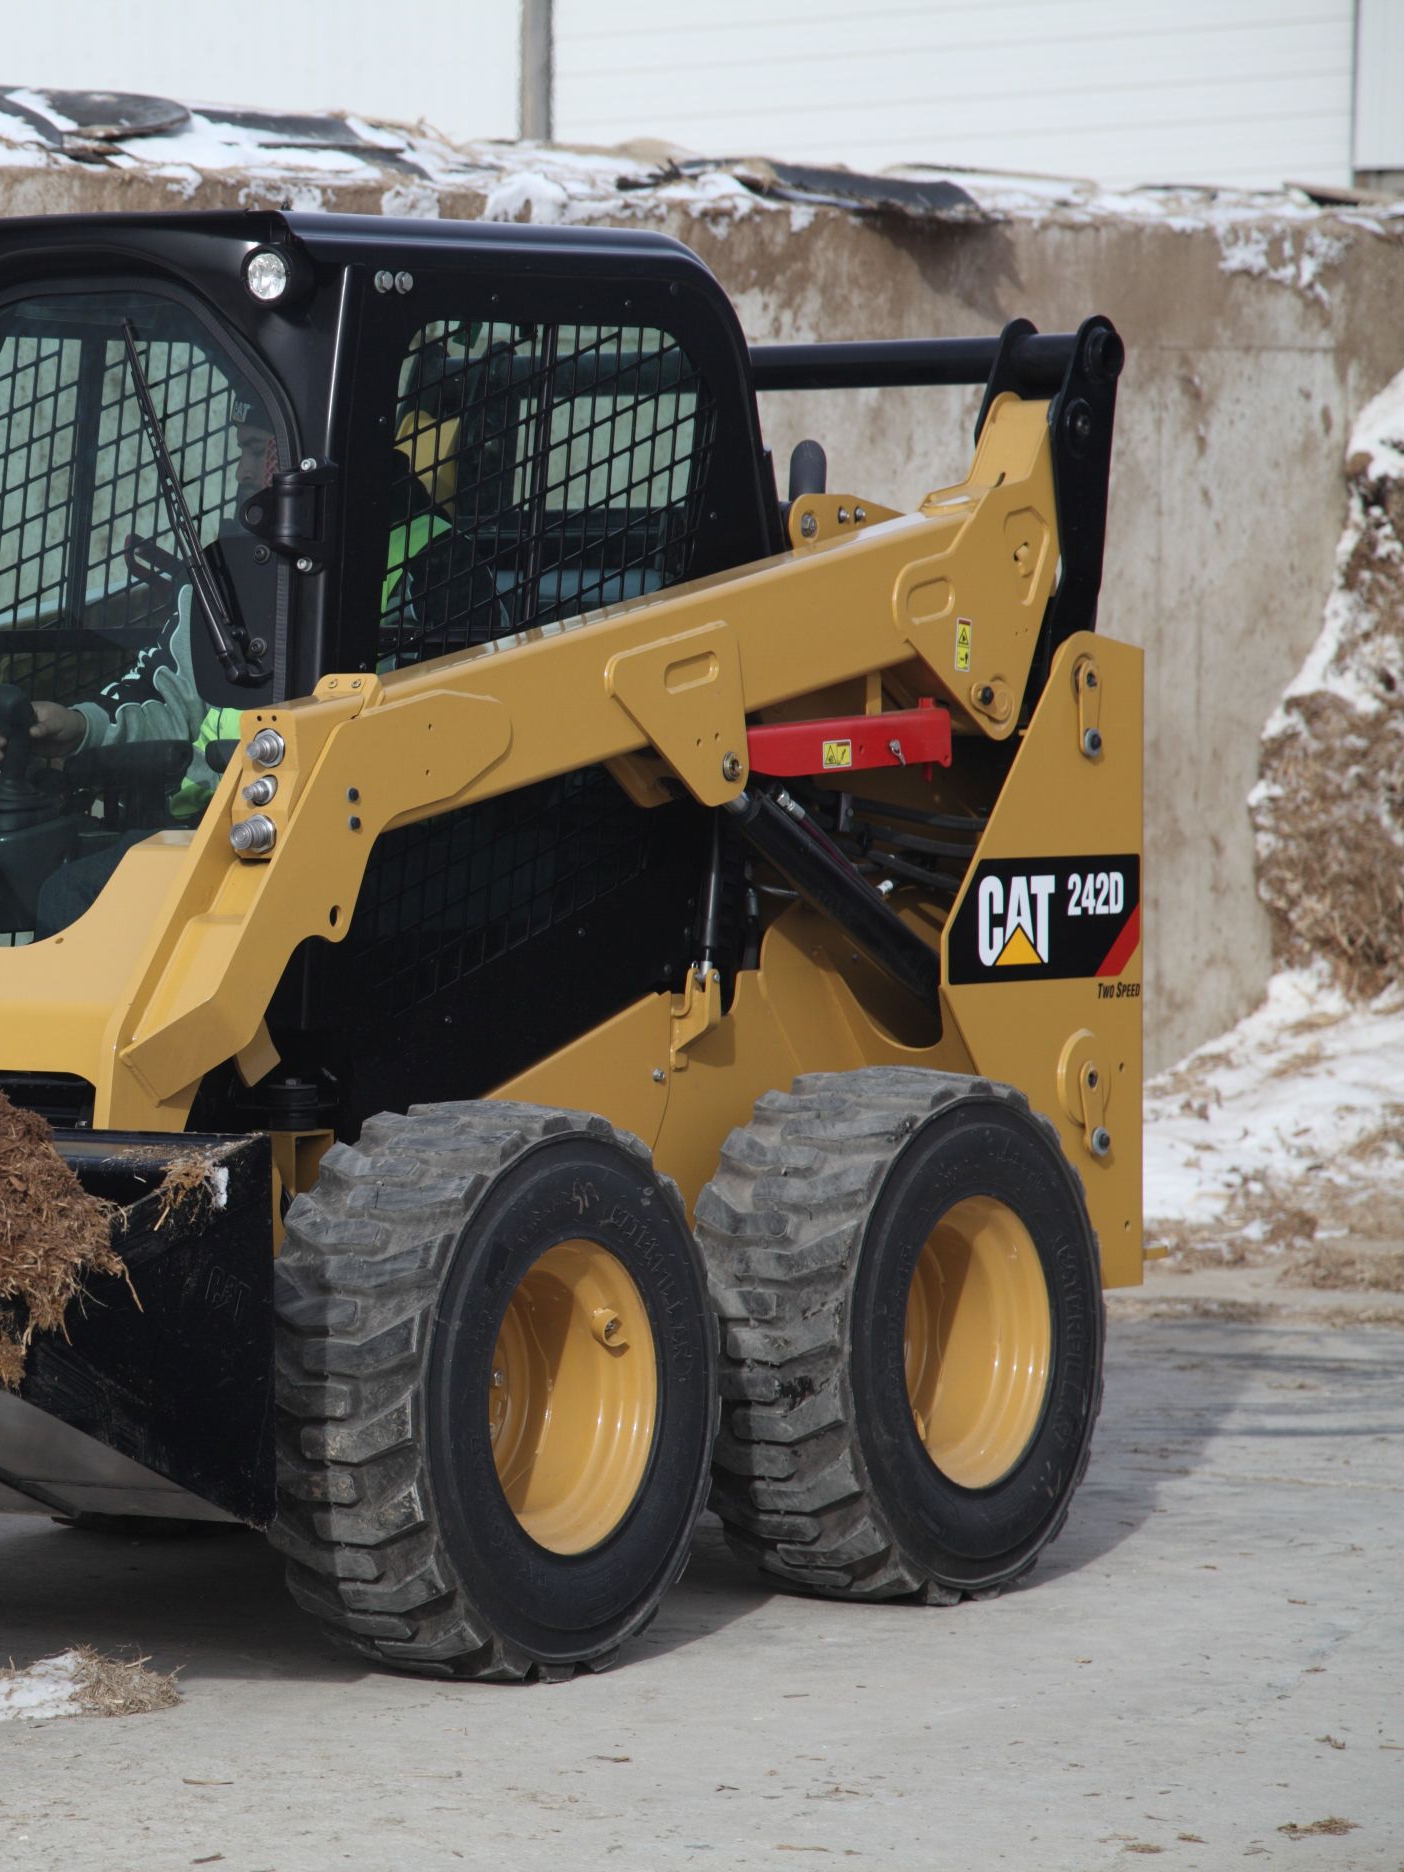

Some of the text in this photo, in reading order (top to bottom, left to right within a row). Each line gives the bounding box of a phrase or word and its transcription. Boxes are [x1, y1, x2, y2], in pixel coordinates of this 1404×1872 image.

[232, 400, 251, 423] CAT
[977, 871, 1125, 967] CAT 242D
